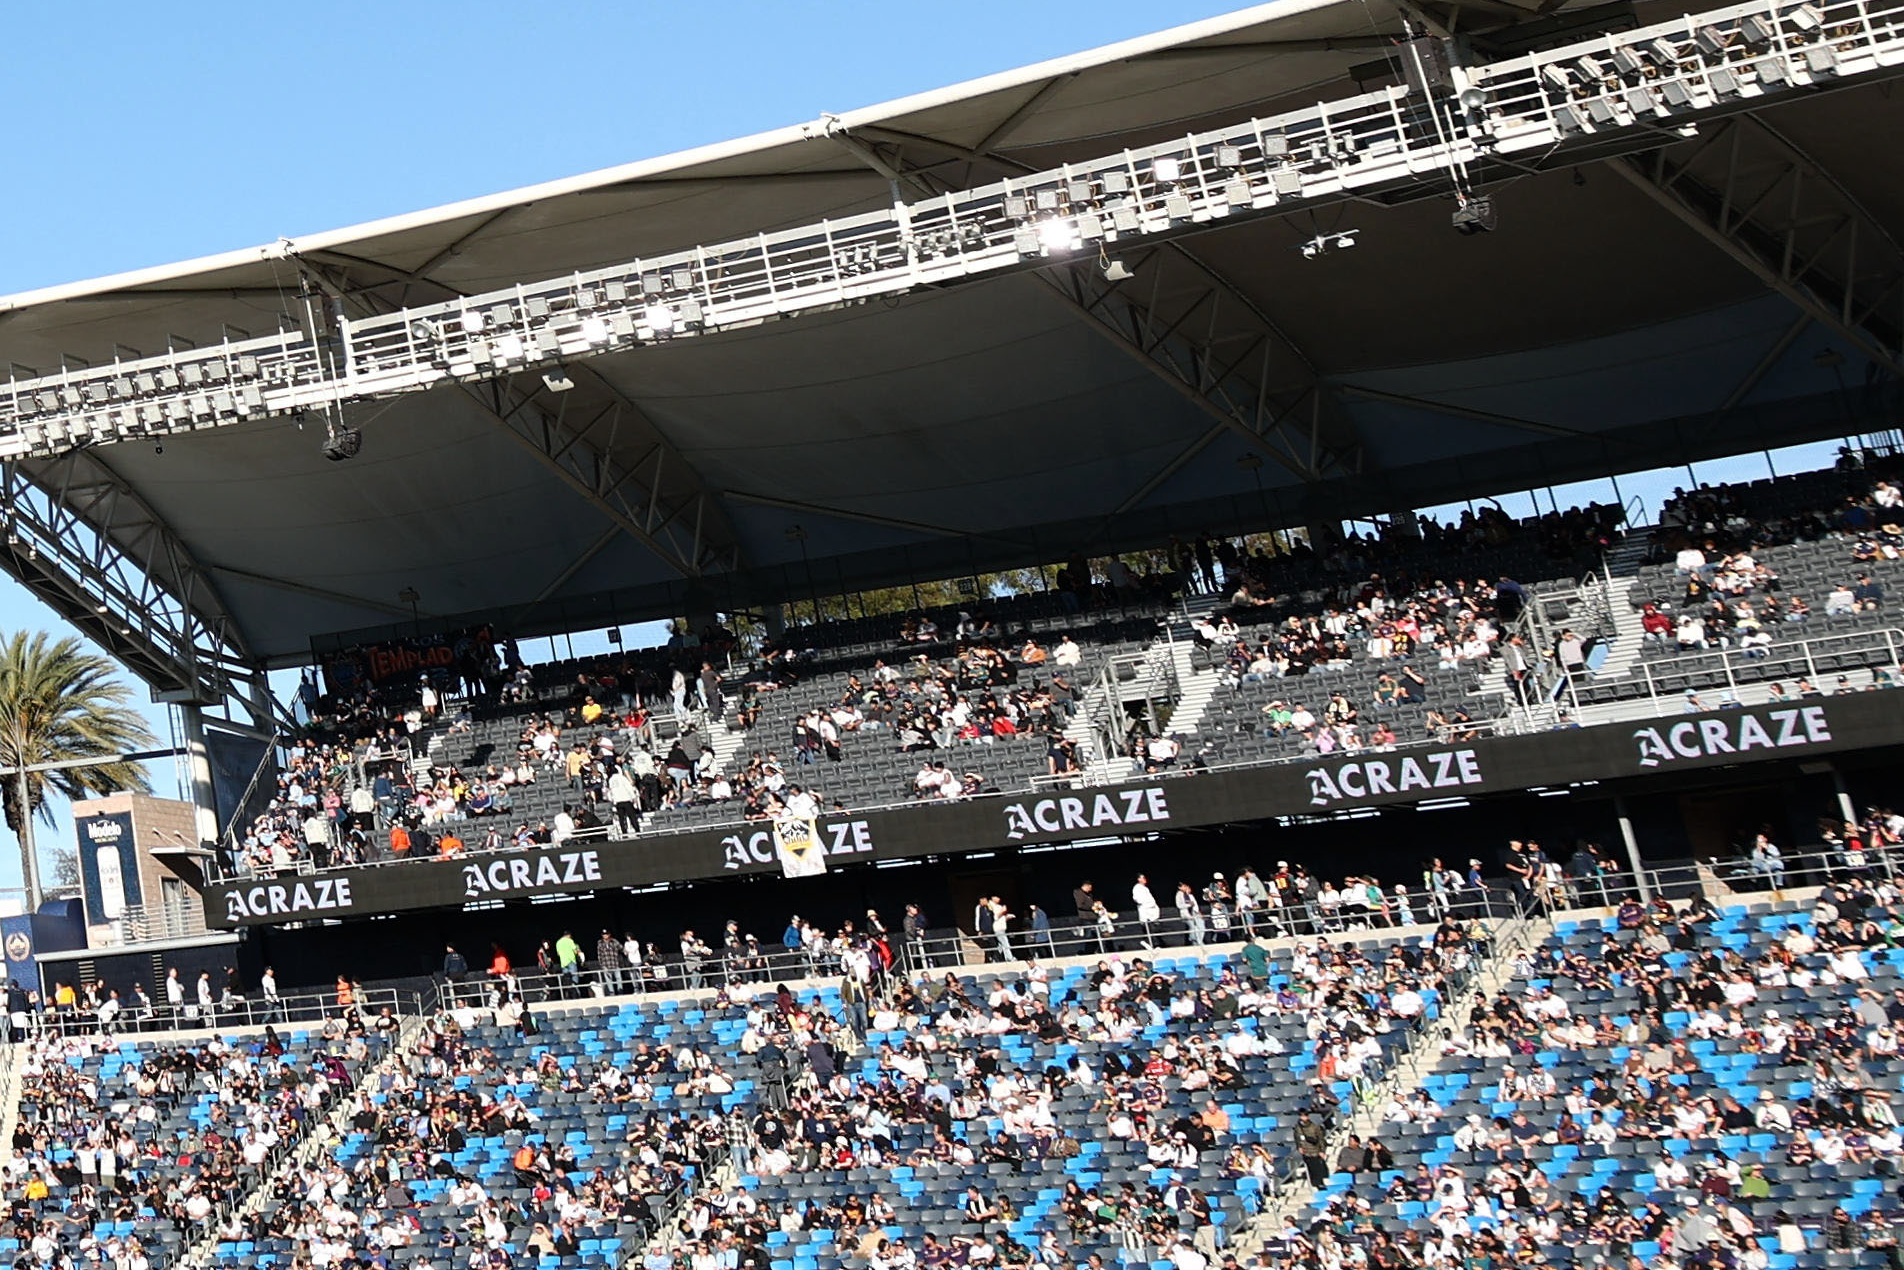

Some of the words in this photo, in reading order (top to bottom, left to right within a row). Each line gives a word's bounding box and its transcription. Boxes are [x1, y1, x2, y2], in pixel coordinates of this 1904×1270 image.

[1631, 706, 1833, 769] ACRAZE
[1304, 749, 1482, 806] ACRAZE
[88, 821, 122, 839] Modelo
[1003, 787, 1170, 840] ACRAZE
[720, 820, 873, 870] ACZE
[462, 851, 602, 897] ACRAZE
[224, 878, 353, 922] ACRAZE
